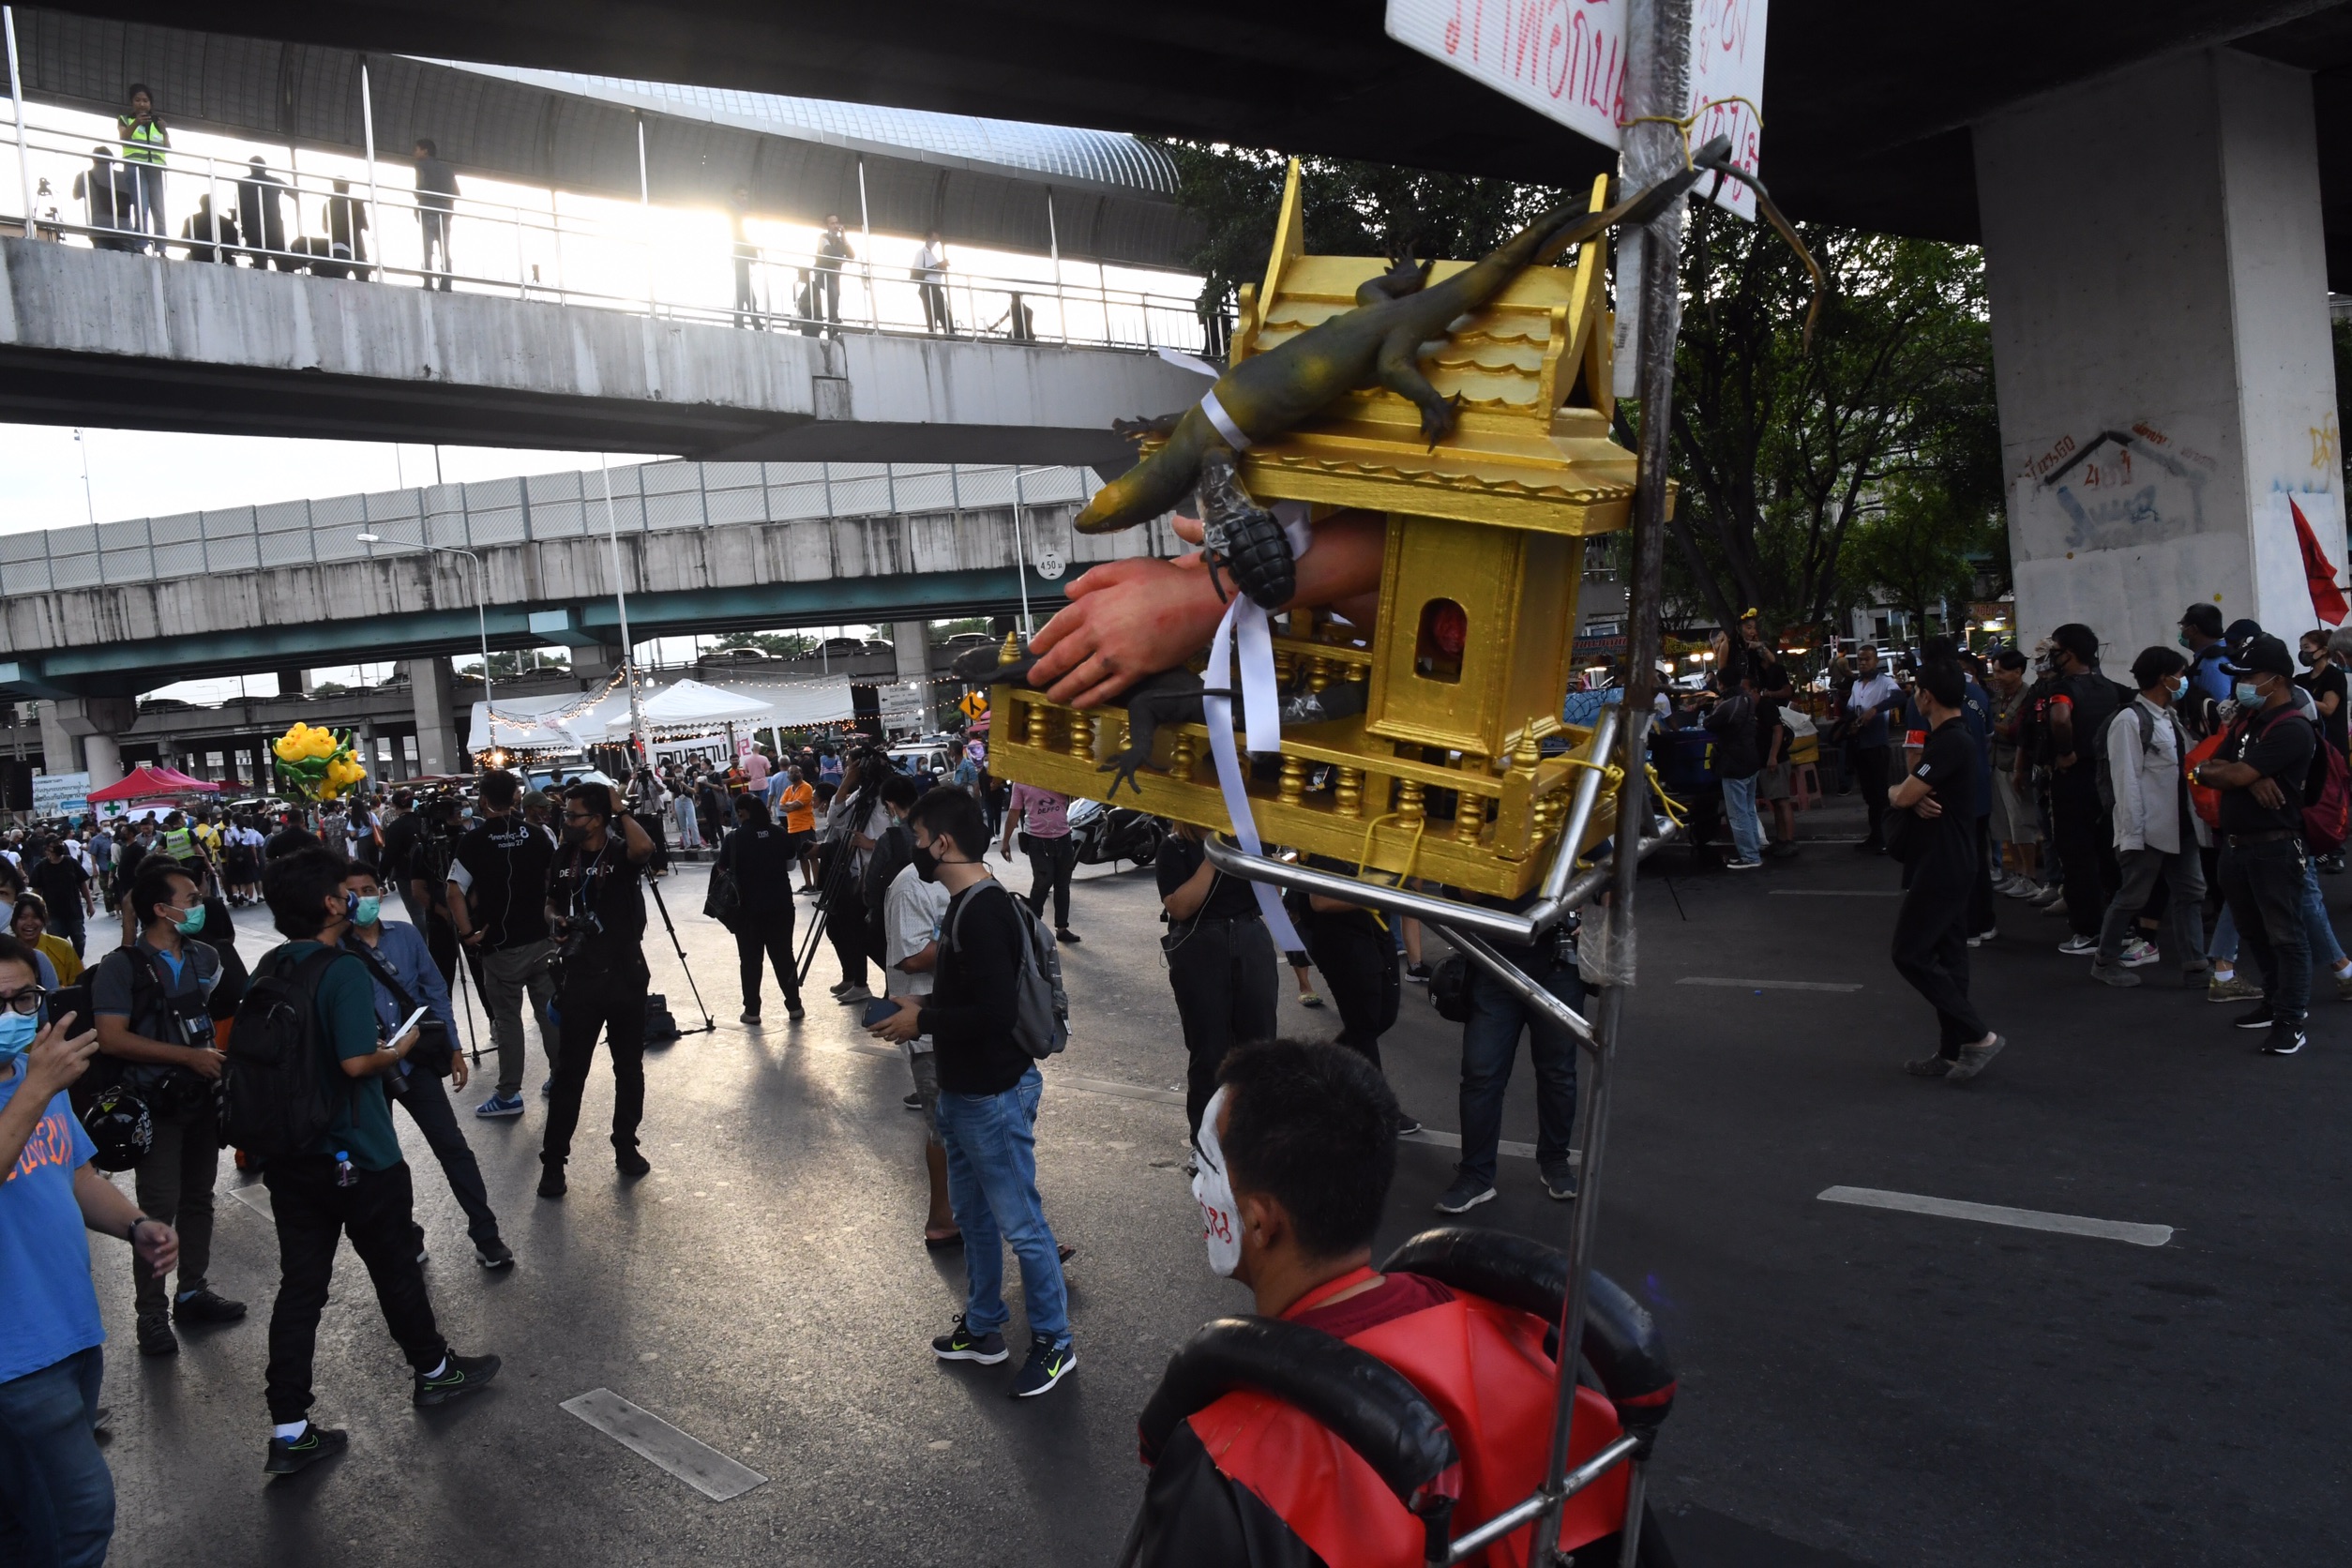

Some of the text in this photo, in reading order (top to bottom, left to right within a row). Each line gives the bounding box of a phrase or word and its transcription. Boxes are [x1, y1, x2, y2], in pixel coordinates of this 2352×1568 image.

[1041, 561, 1056, 570] 4.50
[1038, 806, 1060, 814] DEFFO
[142, 1111, 153, 1153] PRESS
